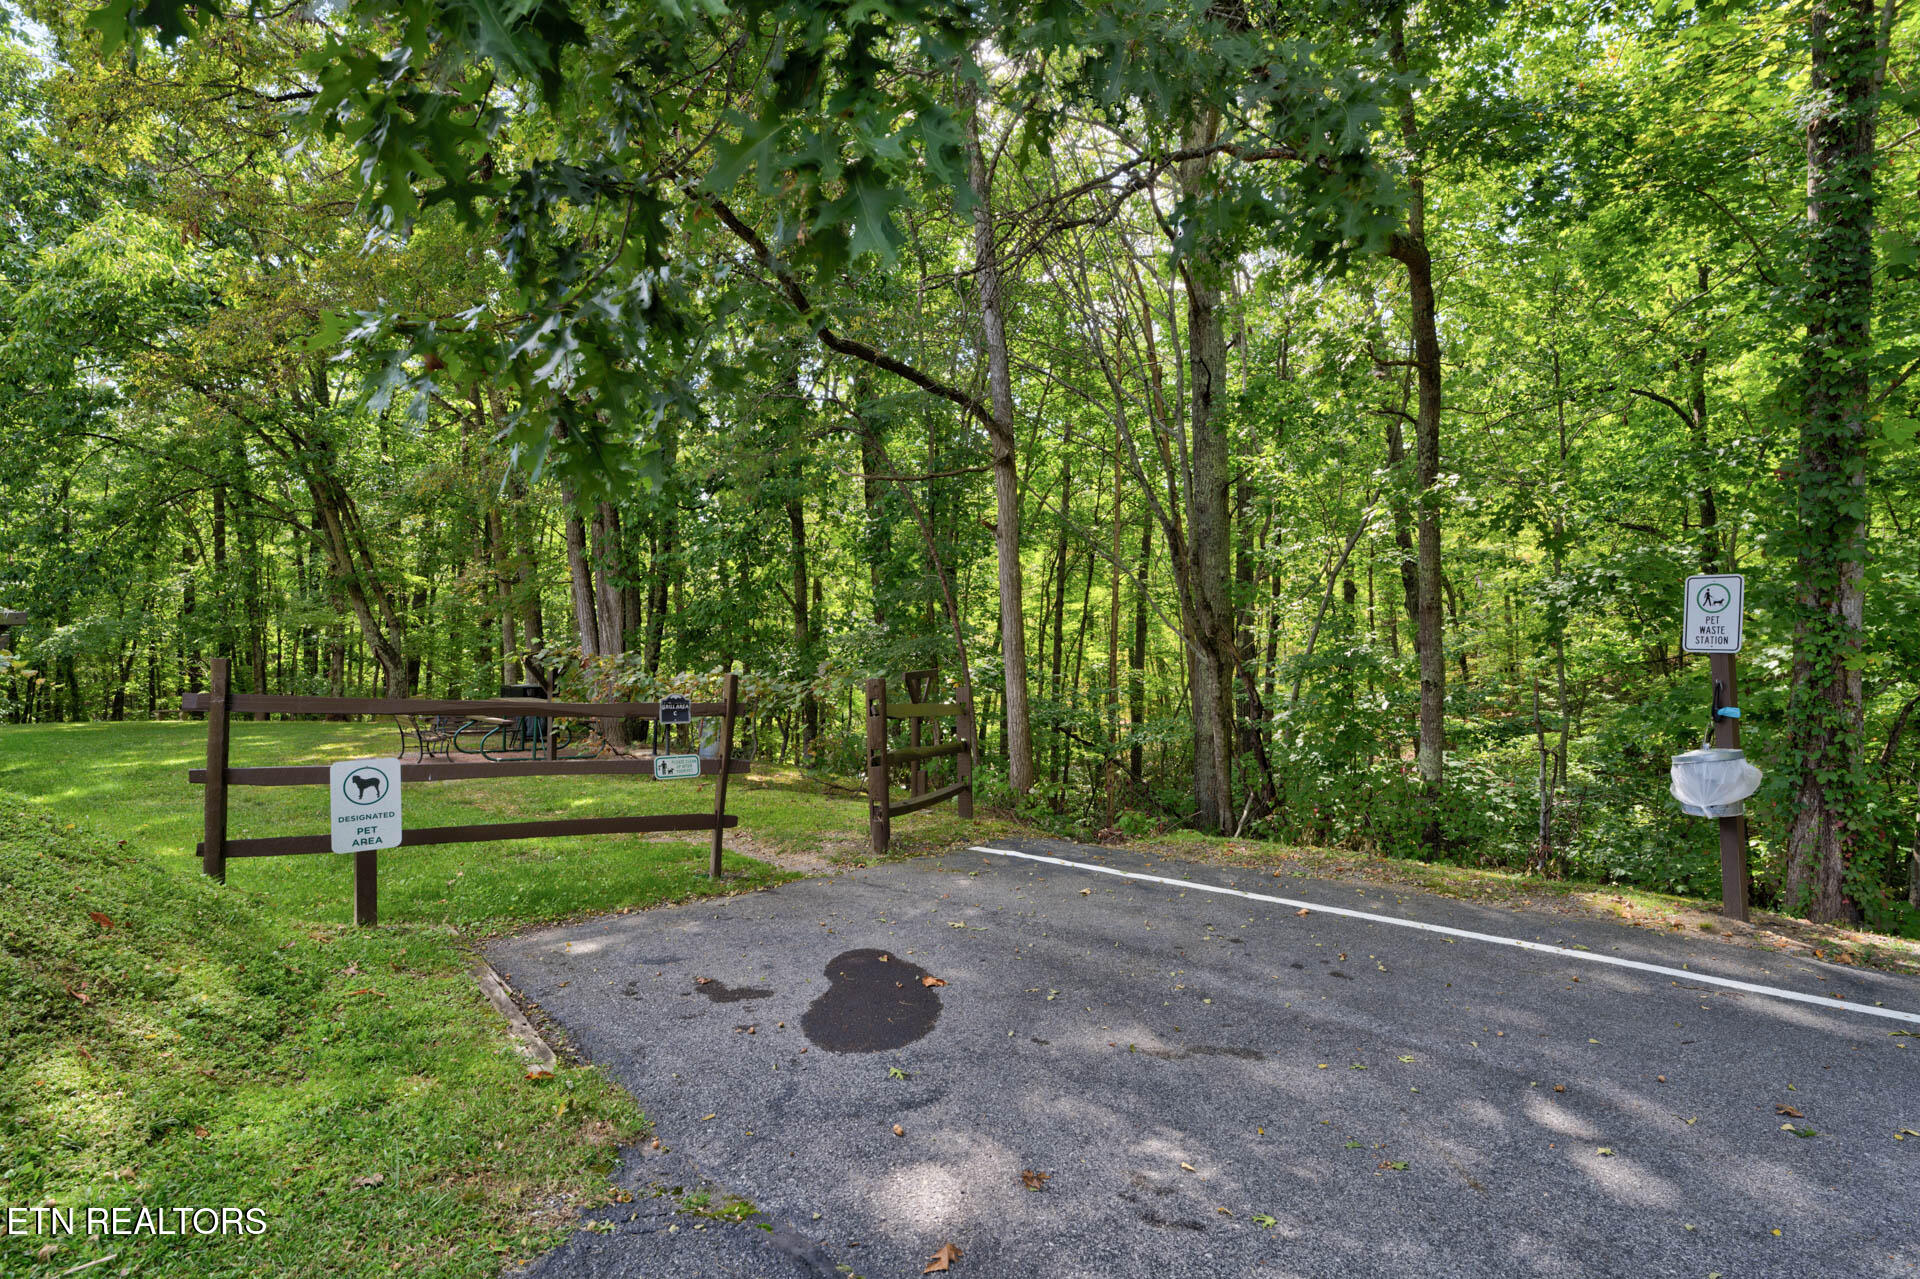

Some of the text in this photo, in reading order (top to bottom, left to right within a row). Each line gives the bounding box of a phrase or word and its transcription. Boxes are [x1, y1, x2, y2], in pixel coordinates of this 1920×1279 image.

[1705, 615, 1720, 625] PET
[1699, 625, 1726, 635] WASTE
[1695, 635, 1729, 645] STATION
[338, 811, 395, 823] DESIGNATED
[357, 826, 377, 835] PET
[352, 836, 383, 847] AREA
